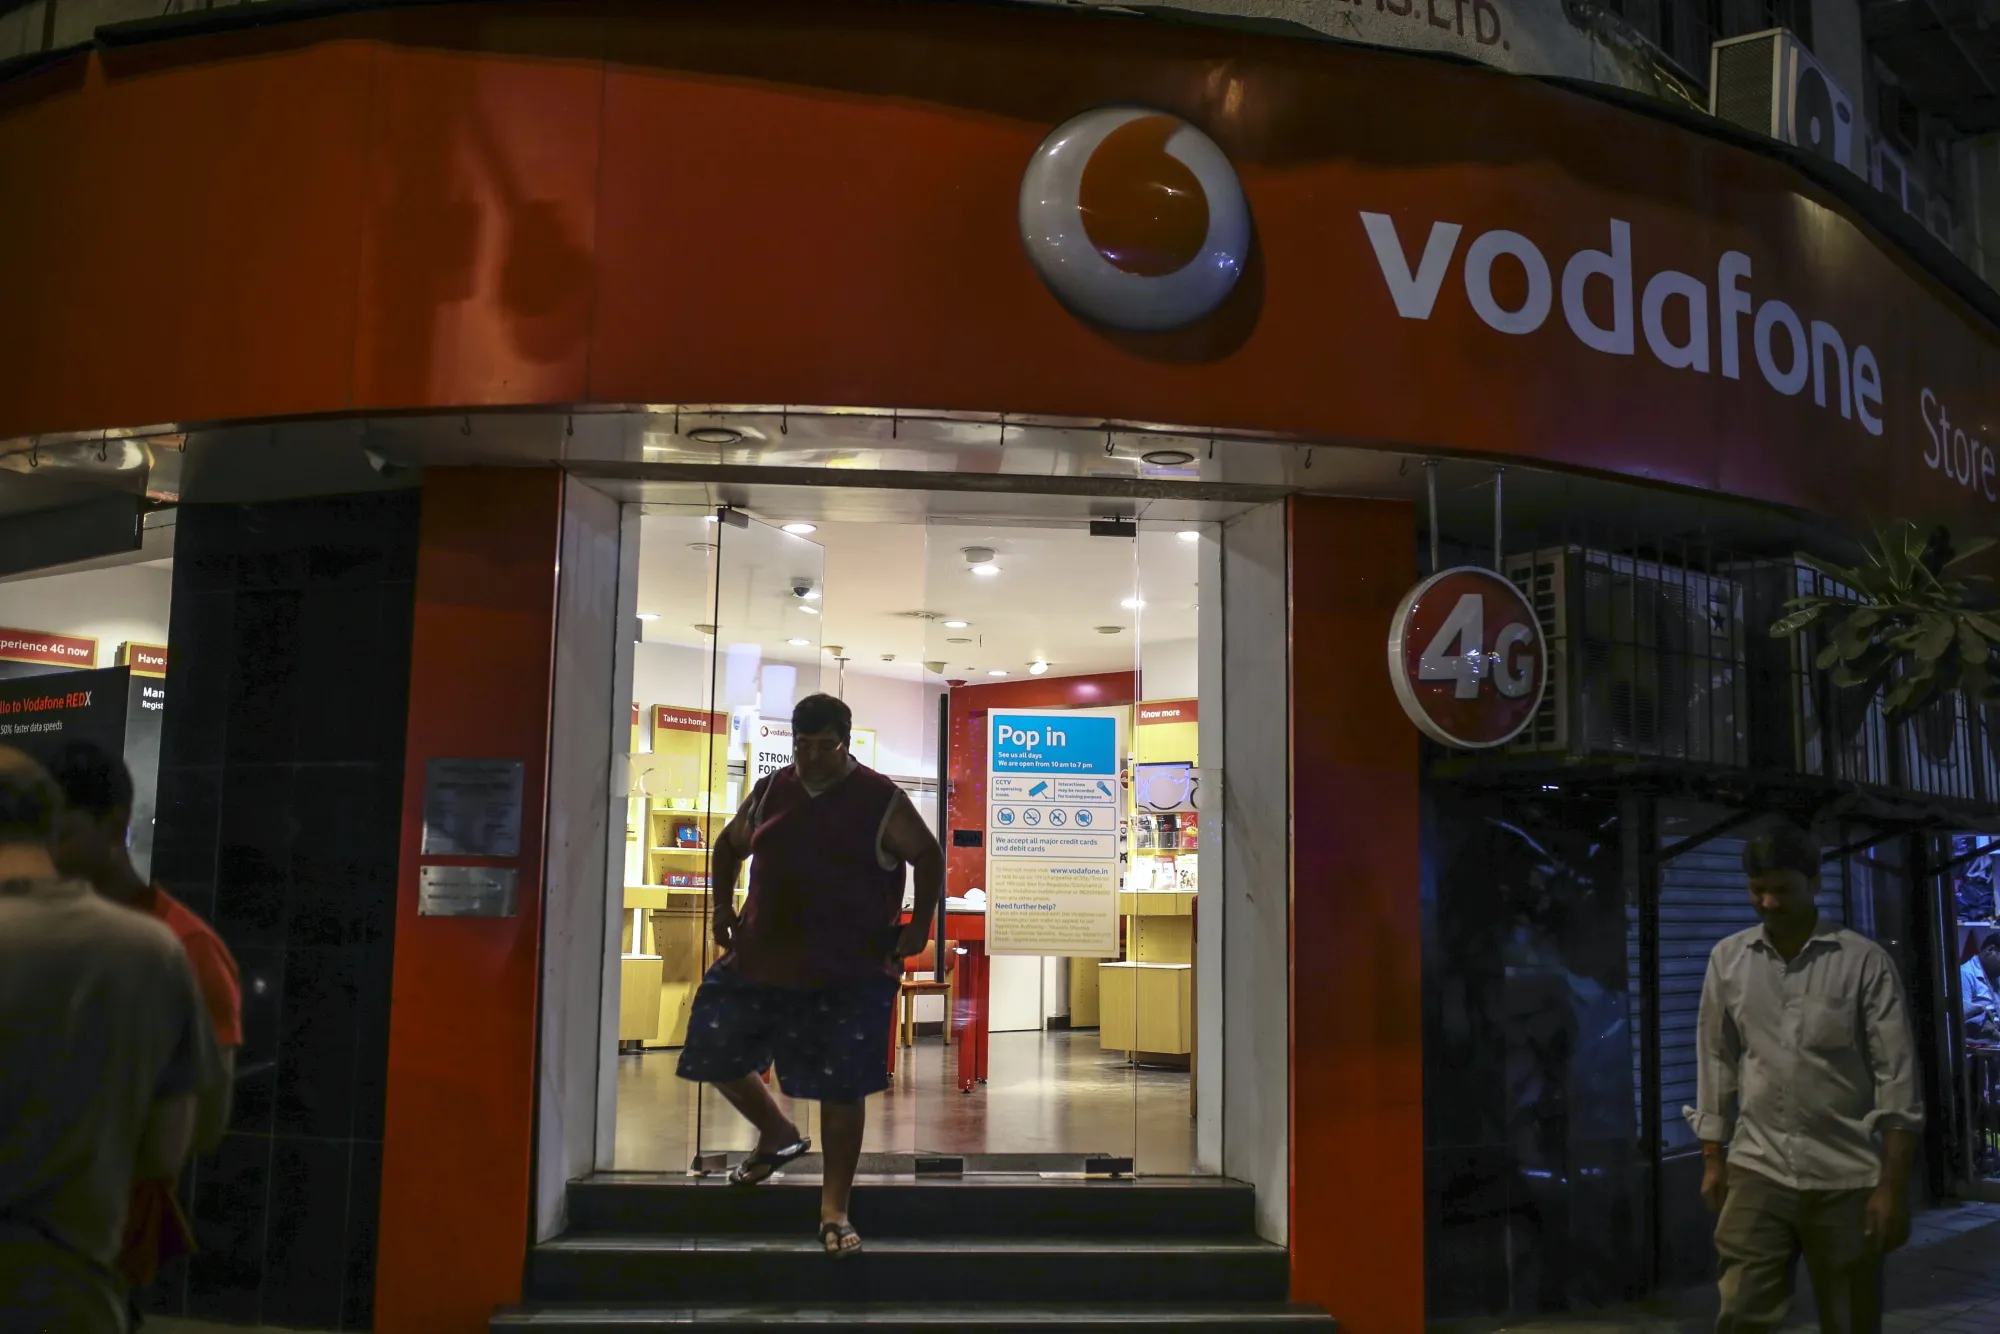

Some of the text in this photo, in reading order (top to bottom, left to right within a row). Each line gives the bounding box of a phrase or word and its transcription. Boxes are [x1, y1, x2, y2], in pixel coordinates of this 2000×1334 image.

[1359, 211, 1996, 503] vodafone Store
[0, 640, 88, 656] perience 4G now
[1418, 593, 1535, 698] 4G
[138, 653, 164, 664] Have
[12, 701, 21, 713] to
[24, 696, 64, 712] Vodafone
[66, 690, 92, 708] REDX
[663, 714, 678, 723] Take
[688, 717, 707, 726] home
[1141, 710, 1161, 719] Know
[14, 723, 30, 734] faster
[30, 722, 42, 732] data
[43, 720, 62, 733] speeds
[998, 725, 1066, 750] Pop in
[1040, 838, 1058, 846] major
